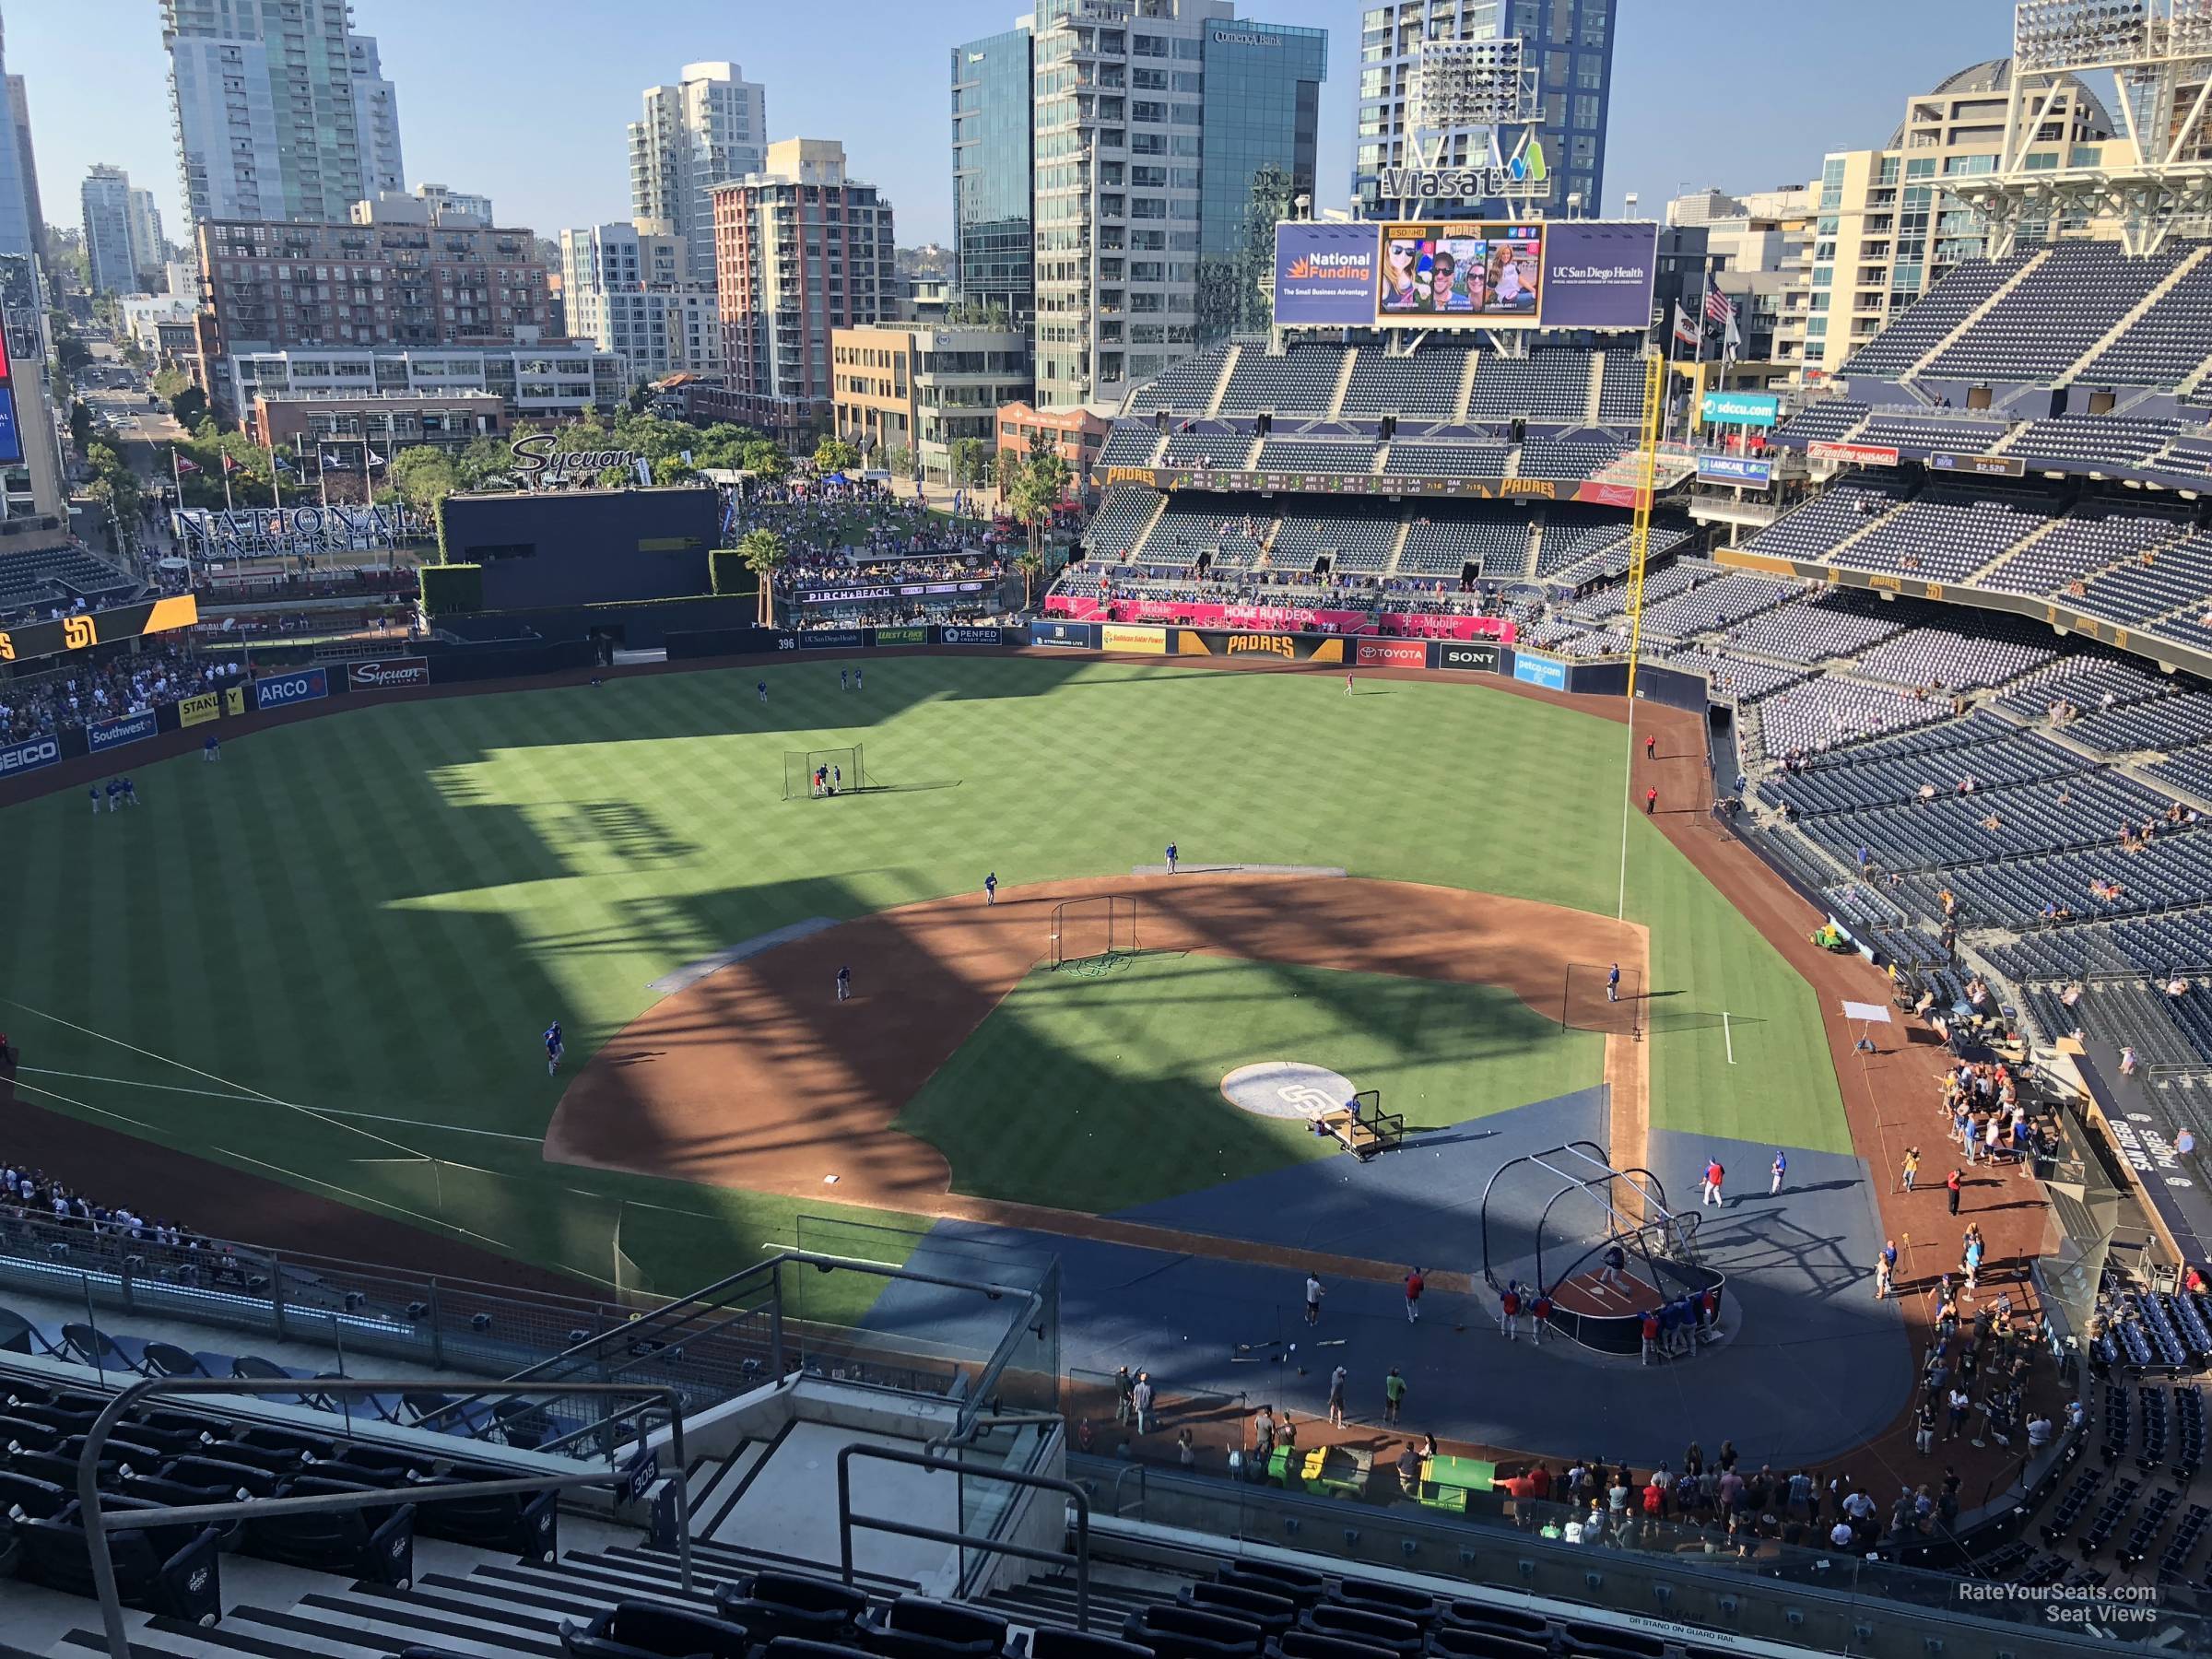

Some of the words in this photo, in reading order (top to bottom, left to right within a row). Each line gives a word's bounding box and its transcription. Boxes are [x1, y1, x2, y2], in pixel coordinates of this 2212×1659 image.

[1259, 35, 1282, 47] Bank
[1385, 166, 1499, 198] Viasat
[1443, 225, 1481, 240] PADRES
[1310, 252, 1371, 265] National
[1309, 265, 1370, 281] Funding
[1553, 266, 1568, 278] UC
[1568, 266, 1585, 278] San
[1587, 266, 1613, 280] Diego
[1614, 266, 1643, 278] Health
[1283, 288, 1295, 296] The
[1295, 288, 1311, 296] Small
[1312, 288, 1336, 296] Business
[1336, 288, 1369, 297] Advantage
[1717, 402, 1774, 417] sdccu.com
[510, 433, 639, 479] Sycuan
[1809, 442, 1855, 461] Tarantino
[1856, 452, 1895, 463] SAUSAGES
[1711, 459, 1746, 474] LANDCARE
[1747, 464, 1769, 475] LOGIC
[1976, 463, 2006, 473] $2,520
[1107, 467, 1156, 487] PADRES
[1500, 478, 1556, 499] PADRES
[173, 502, 416, 540] NATIONAL
[197, 530, 398, 559] UNIVERSITY
[1869, 574, 1901, 593] PADRES
[809, 591, 850, 602] PIRCH
[855, 588, 890, 598] BEACH
[1067, 599, 1077, 612] T
[1139, 603, 1172, 614] Mobile
[1224, 606, 1257, 618] HOME
[1260, 607, 1283, 620] RUN
[1285, 609, 1316, 622] DECK
[1403, 616, 1412, 627] T
[1423, 617, 1459, 629] Mobile
[2075, 617, 2100, 637] PADRES
[824, 635, 841, 643] Diego
[878, 631, 900, 640] WEST
[960, 629, 996, 639] PENFED
[1135, 634, 1147, 642] Solar
[1147, 636, 1164, 644] Power
[778, 639, 794, 650] 396
[1227, 634, 1295, 659] PADRES
[1377, 648, 1422, 659] TOYOTA
[1449, 652, 1495, 664] SONY
[357, 664, 421, 685] Sycuan
[1519, 659, 1561, 677] petco.com
[260, 679, 308, 702] ARCO
[182, 692, 237, 715] STANLY
[93, 720, 146, 745] Southwest
[2109, 1119, 2142, 1149] DIEGO
[2139, 1129, 2179, 1169] PADRES
[2124, 1150, 2155, 1171] SAN
[634, 1461, 655, 1494] 308
[1642, 1619, 1670, 1630] STAND
[1672, 1624, 1685, 1633] ON
[1686, 1627, 1715, 1639] GUARD
[1717, 1633, 1735, 1643] RAIL
